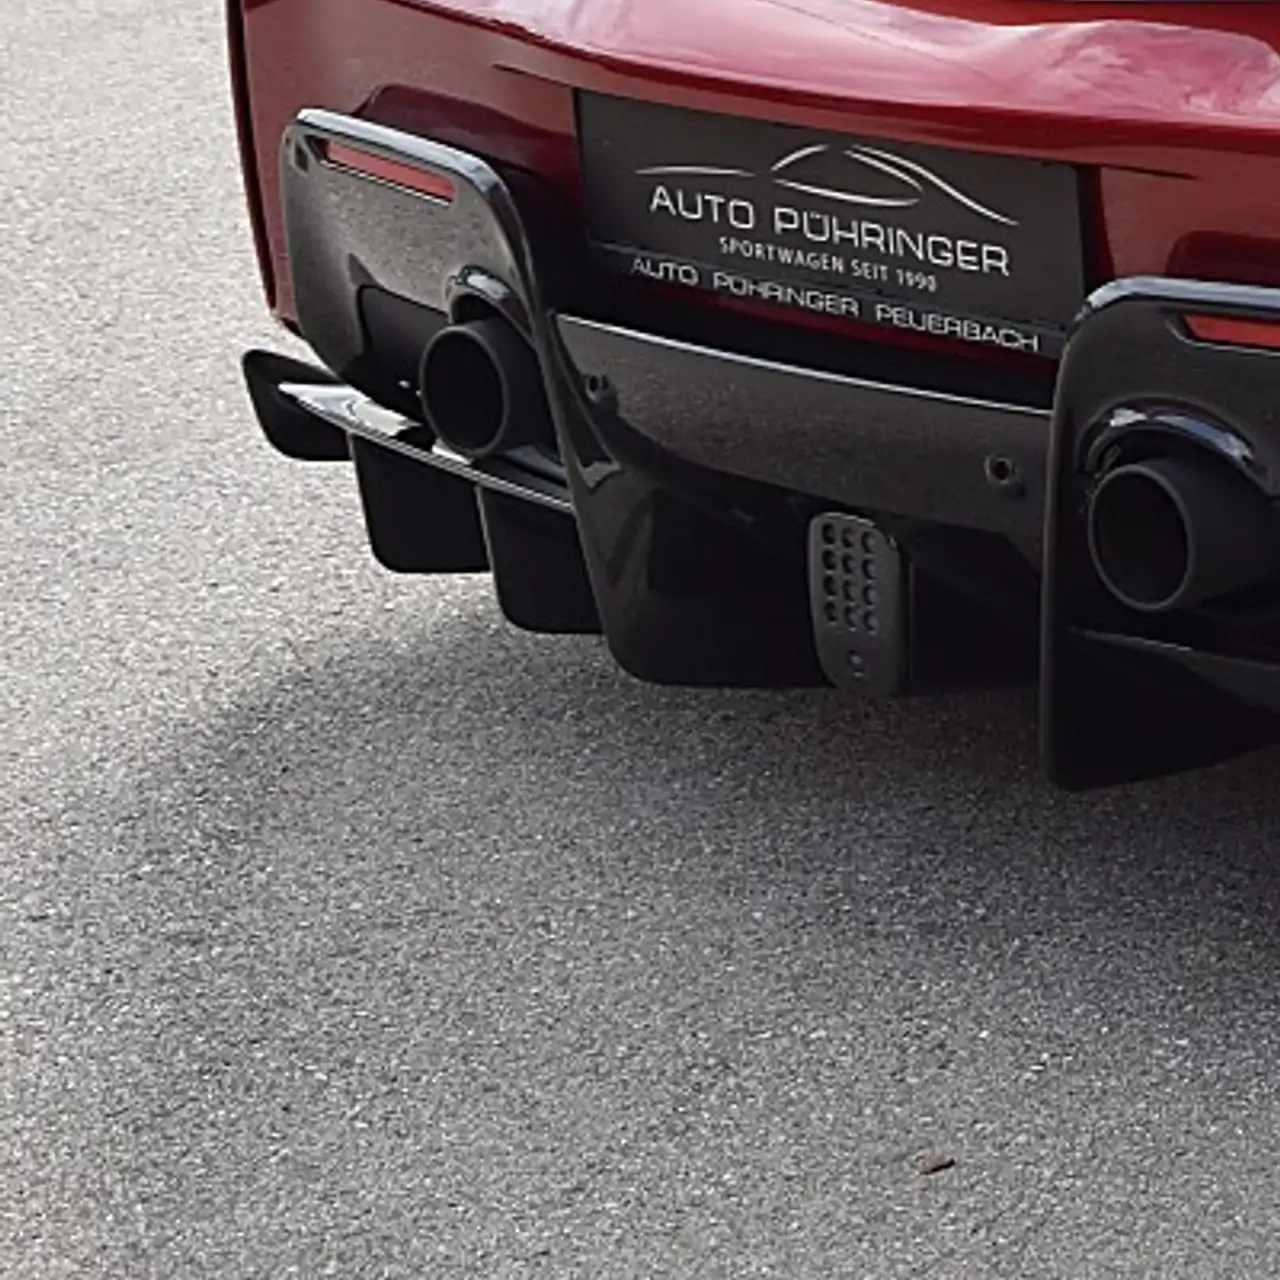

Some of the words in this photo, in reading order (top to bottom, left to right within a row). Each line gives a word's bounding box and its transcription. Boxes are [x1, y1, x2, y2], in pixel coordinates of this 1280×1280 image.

[648, 184, 756, 229] AUTO
[773, 206, 1010, 277] PÜHRINGER
[718, 236, 845, 274] SPORTWAGEN
[850, 260, 889, 283] SEIT
[631, 257, 699, 286] AUTO
[876, 302, 1040, 352] PEUERBACH
